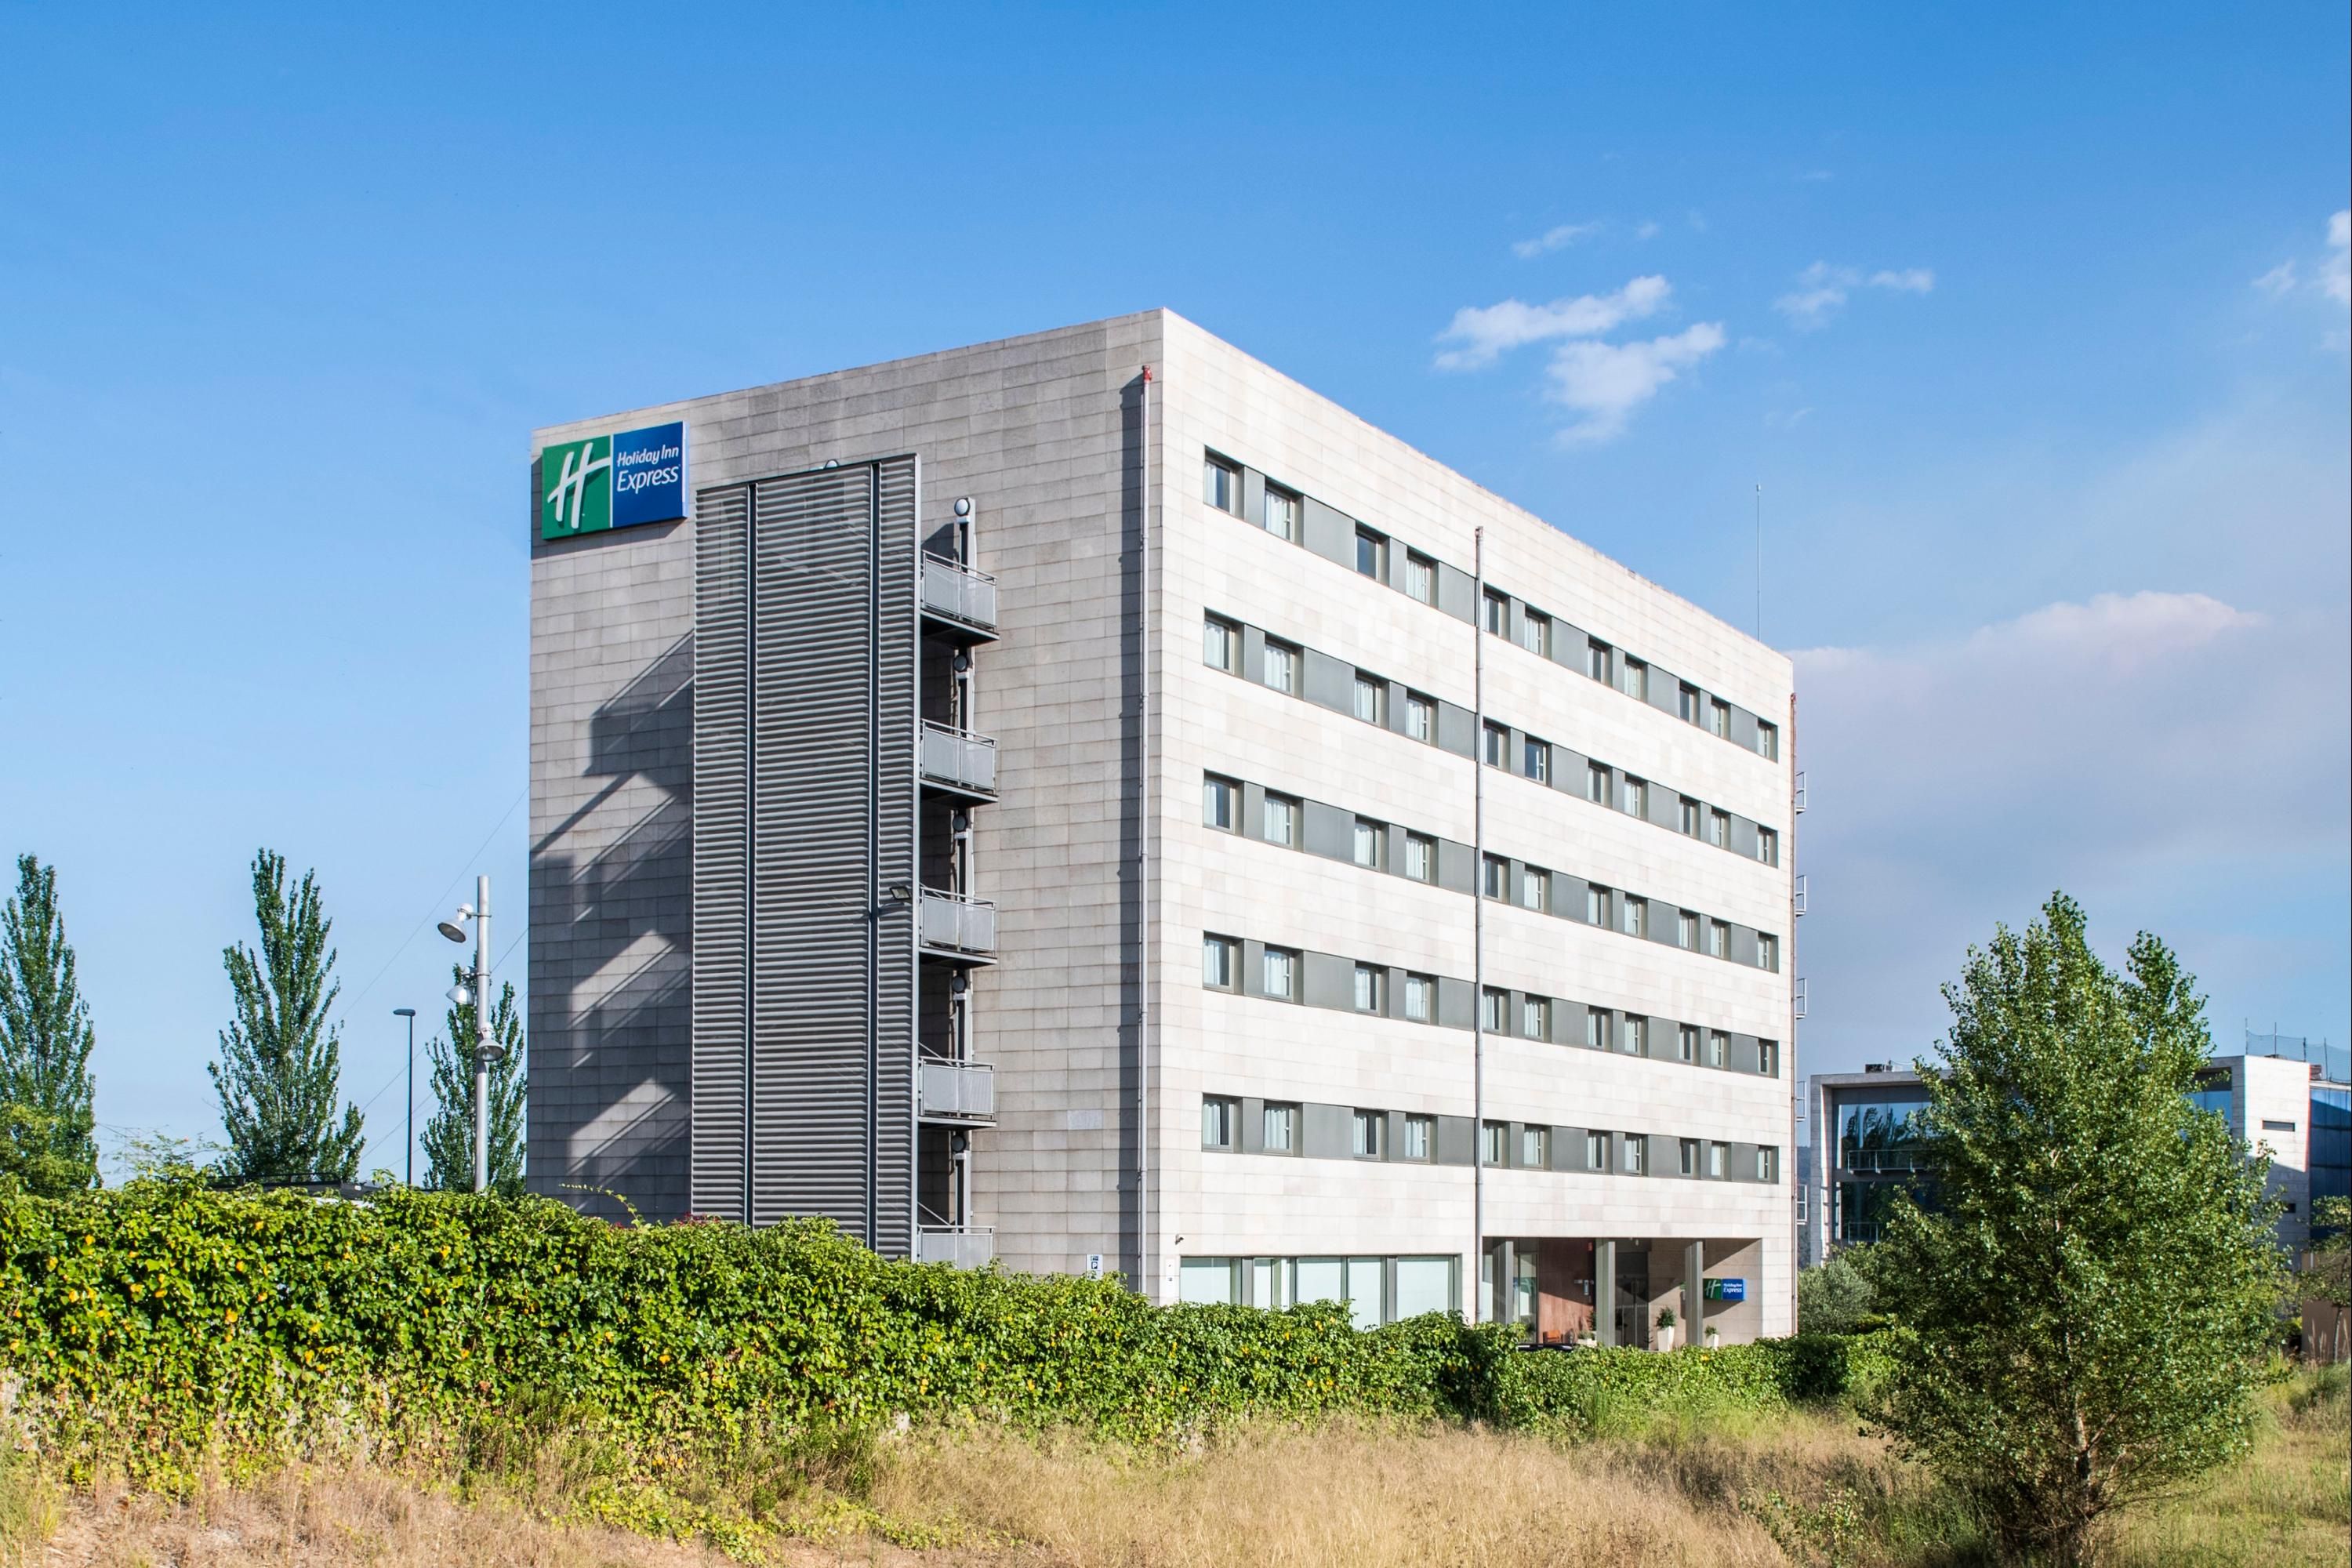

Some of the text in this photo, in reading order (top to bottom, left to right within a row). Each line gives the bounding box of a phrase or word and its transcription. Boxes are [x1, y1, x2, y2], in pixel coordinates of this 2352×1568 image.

[617, 445, 679, 467] Holiday Inn
[617, 466, 679, 494] Express
